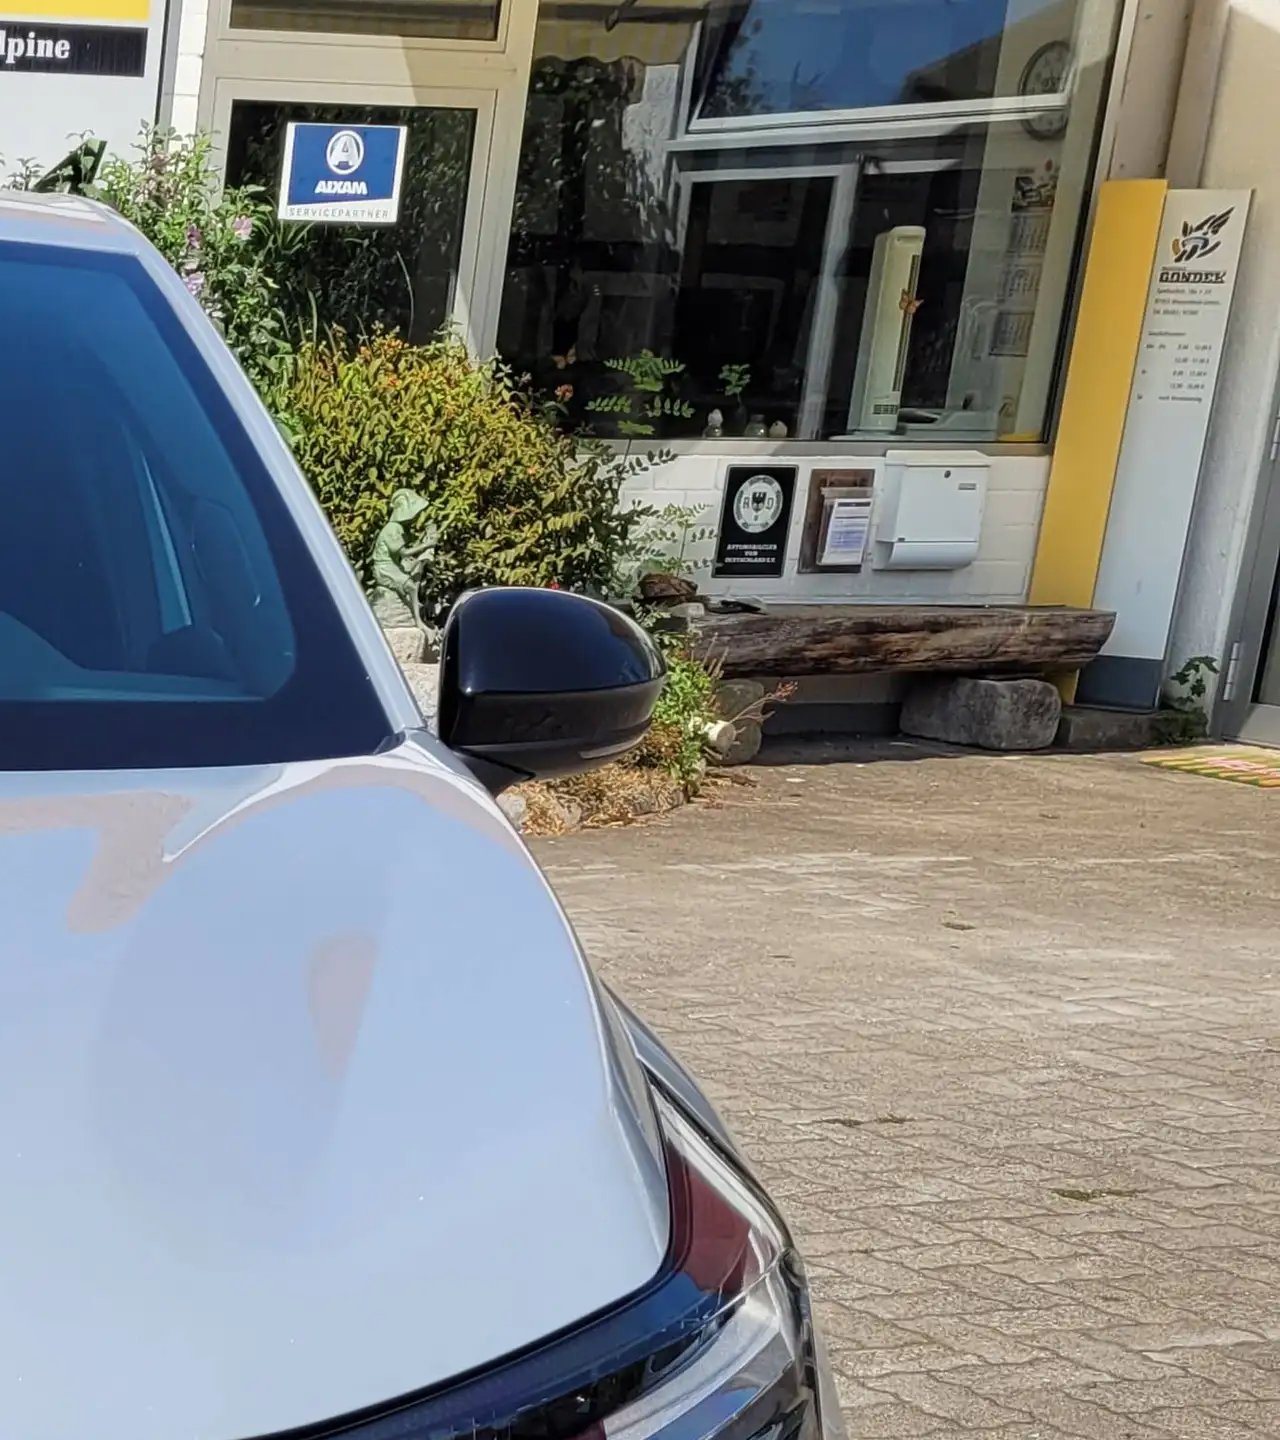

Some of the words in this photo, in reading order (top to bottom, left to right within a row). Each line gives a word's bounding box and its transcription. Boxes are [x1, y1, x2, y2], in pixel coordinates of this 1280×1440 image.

[314, 180, 368, 195] AIXAM
[289, 207, 389, 219] SERVICEPARTNER
[1159, 271, 1227, 284] GONDEK
